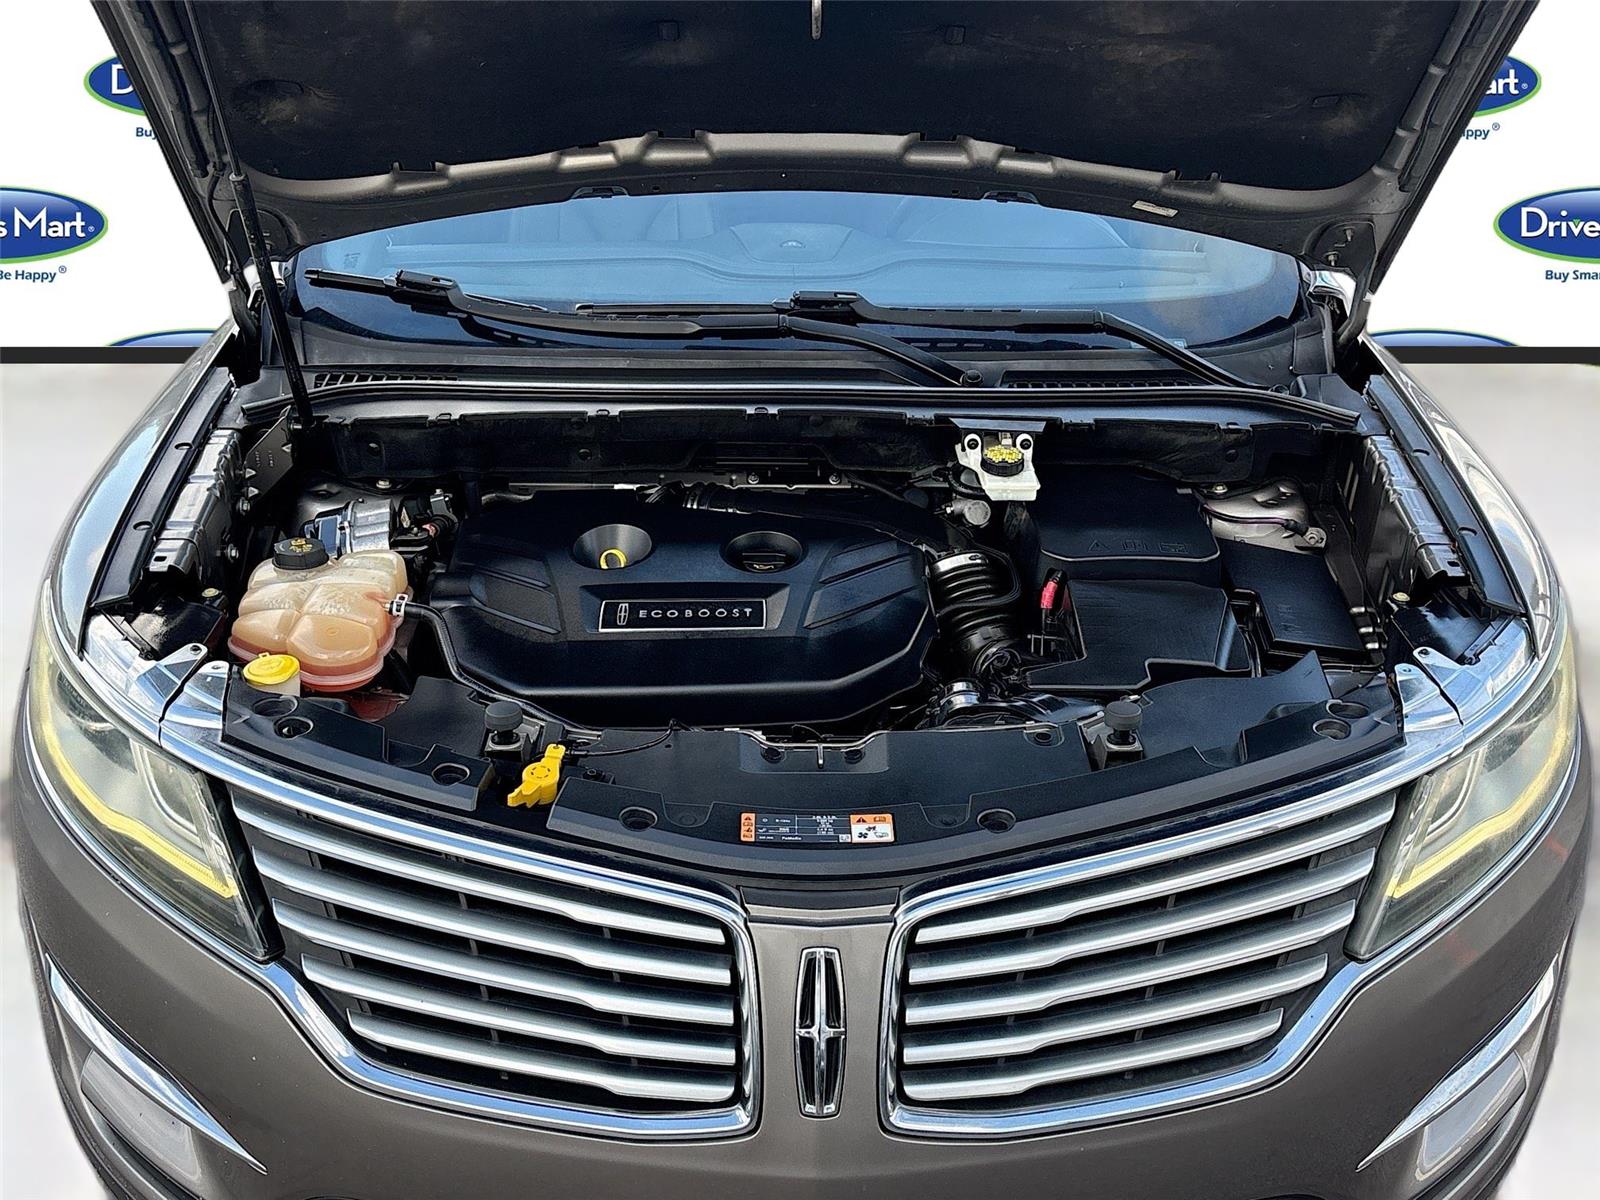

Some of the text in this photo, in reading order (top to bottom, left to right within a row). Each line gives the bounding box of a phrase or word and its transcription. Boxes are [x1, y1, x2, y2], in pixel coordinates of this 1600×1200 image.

[1485, 68, 1519, 95] art
[1462, 128, 1490, 140] ppy
[1545, 269, 1570, 283] Buy
[638, 607, 753, 618] ECOBOOST
